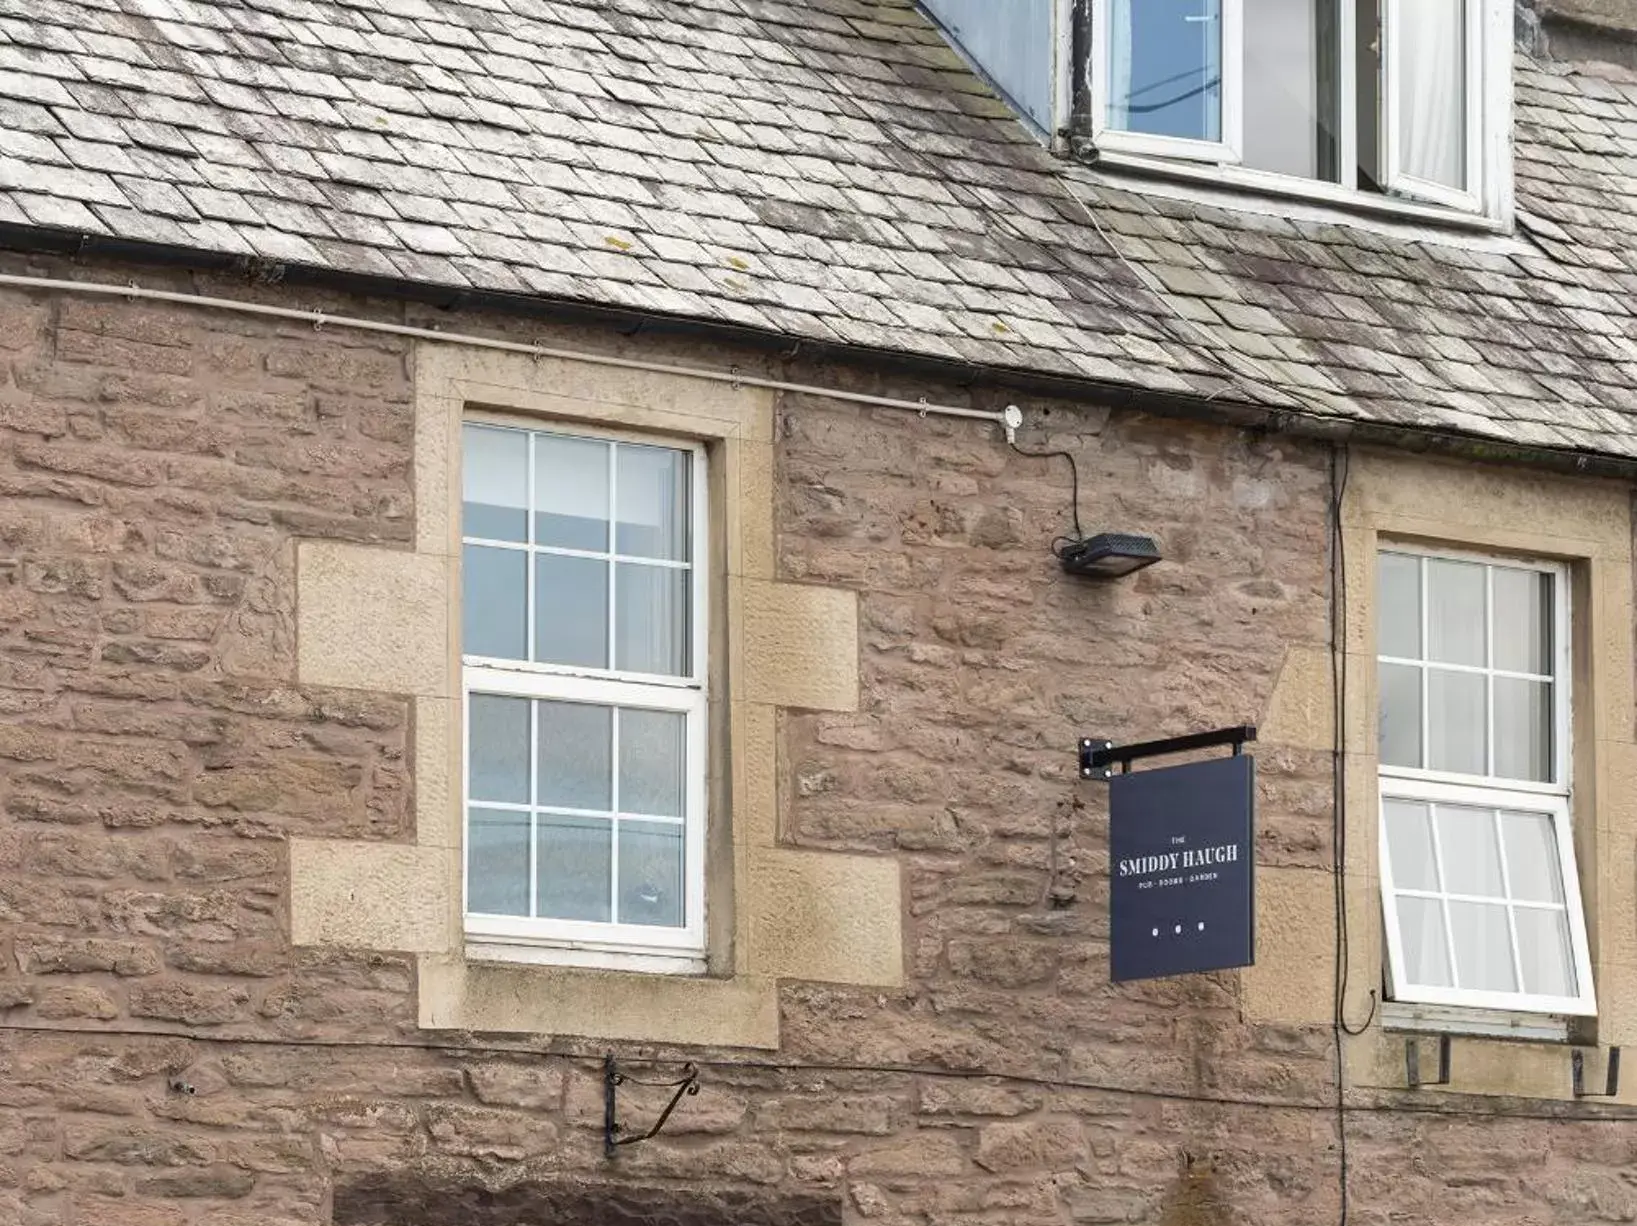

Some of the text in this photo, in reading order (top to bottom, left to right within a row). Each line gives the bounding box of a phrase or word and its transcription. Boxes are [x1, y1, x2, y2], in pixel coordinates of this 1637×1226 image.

[1171, 836, 1185, 844] THE
[1119, 844, 1238, 877] SMIDDY HAUGH
